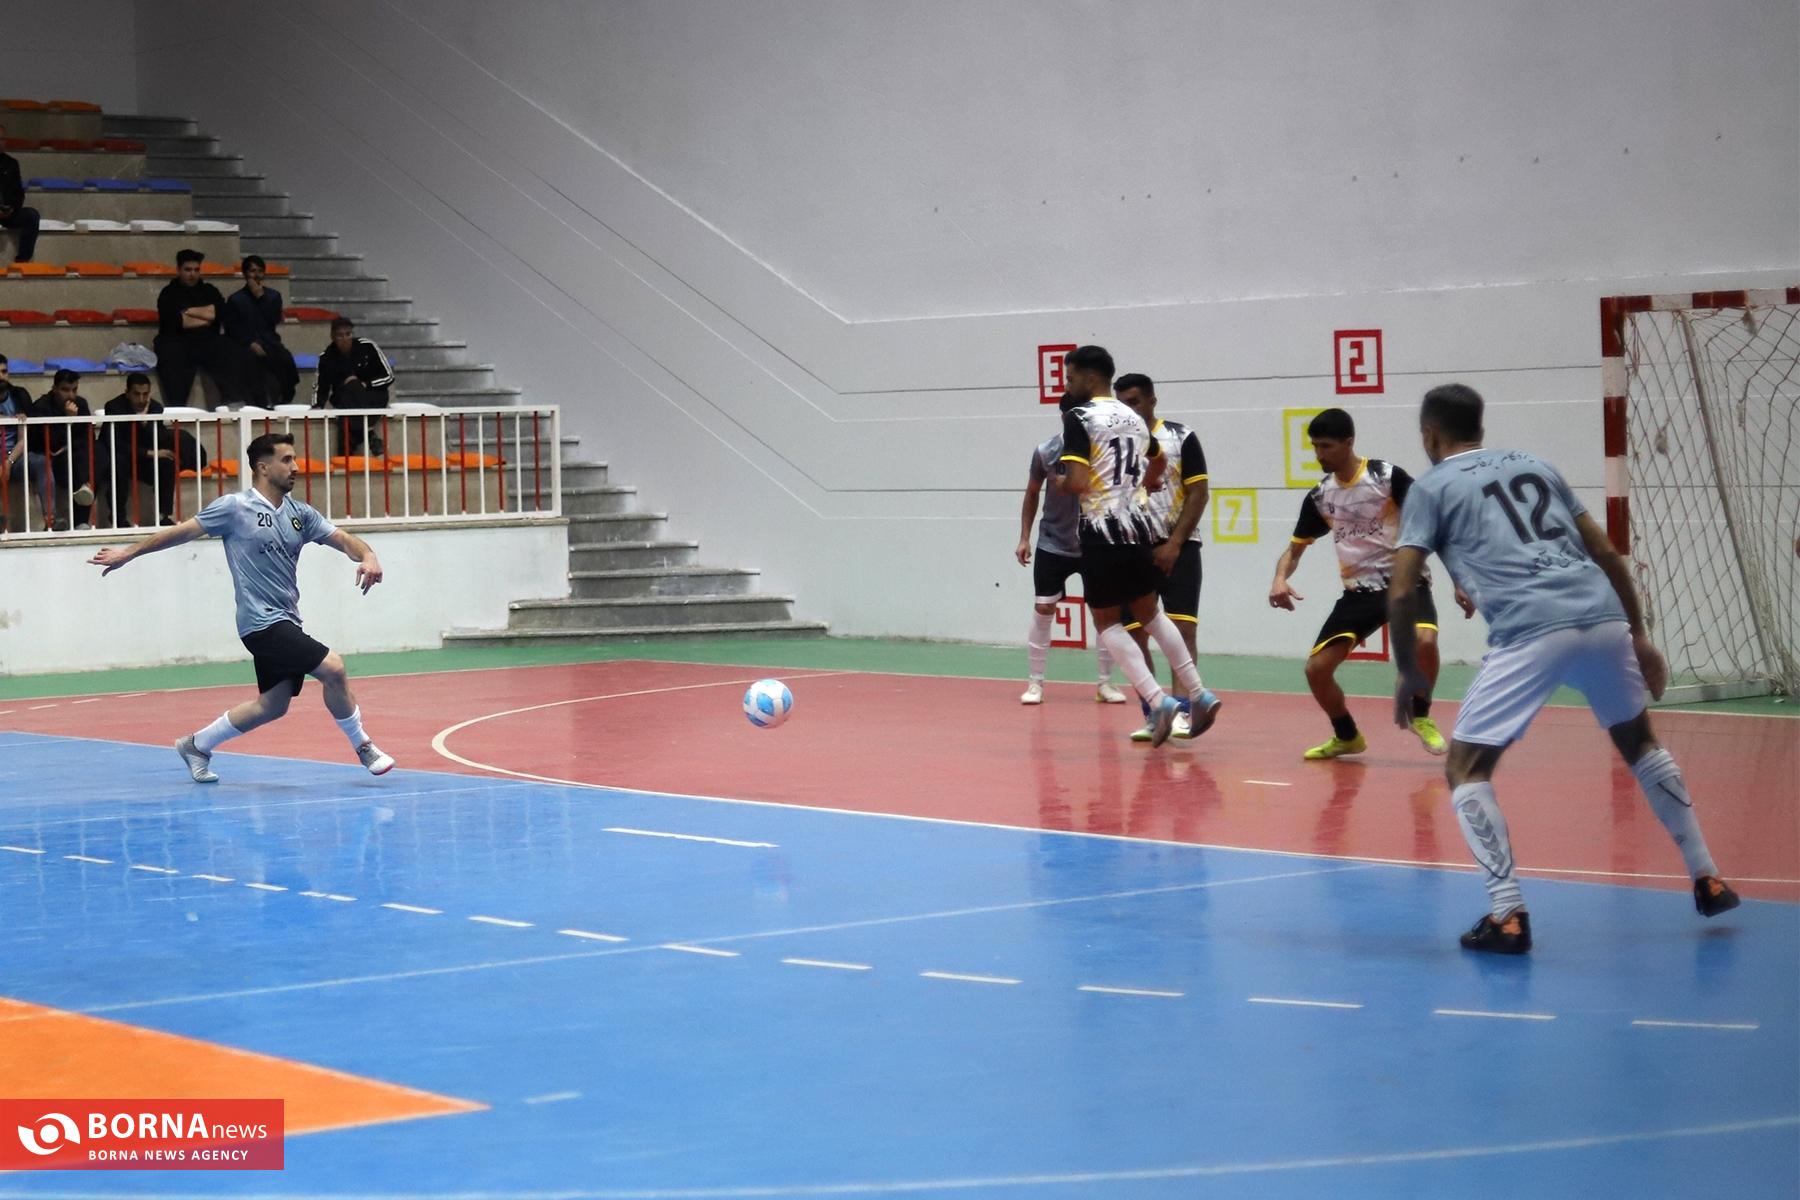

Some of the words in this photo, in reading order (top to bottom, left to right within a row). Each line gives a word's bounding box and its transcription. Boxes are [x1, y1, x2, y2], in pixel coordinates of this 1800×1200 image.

[1049, 355, 1065, 393] 3
[1349, 340, 1368, 383] 2
[1108, 436, 1141, 488] 14
[256, 512, 273, 528] 20
[1224, 499, 1243, 532] 7
[1481, 472, 1568, 545] 12
[1055, 606, 1072, 638] 4
